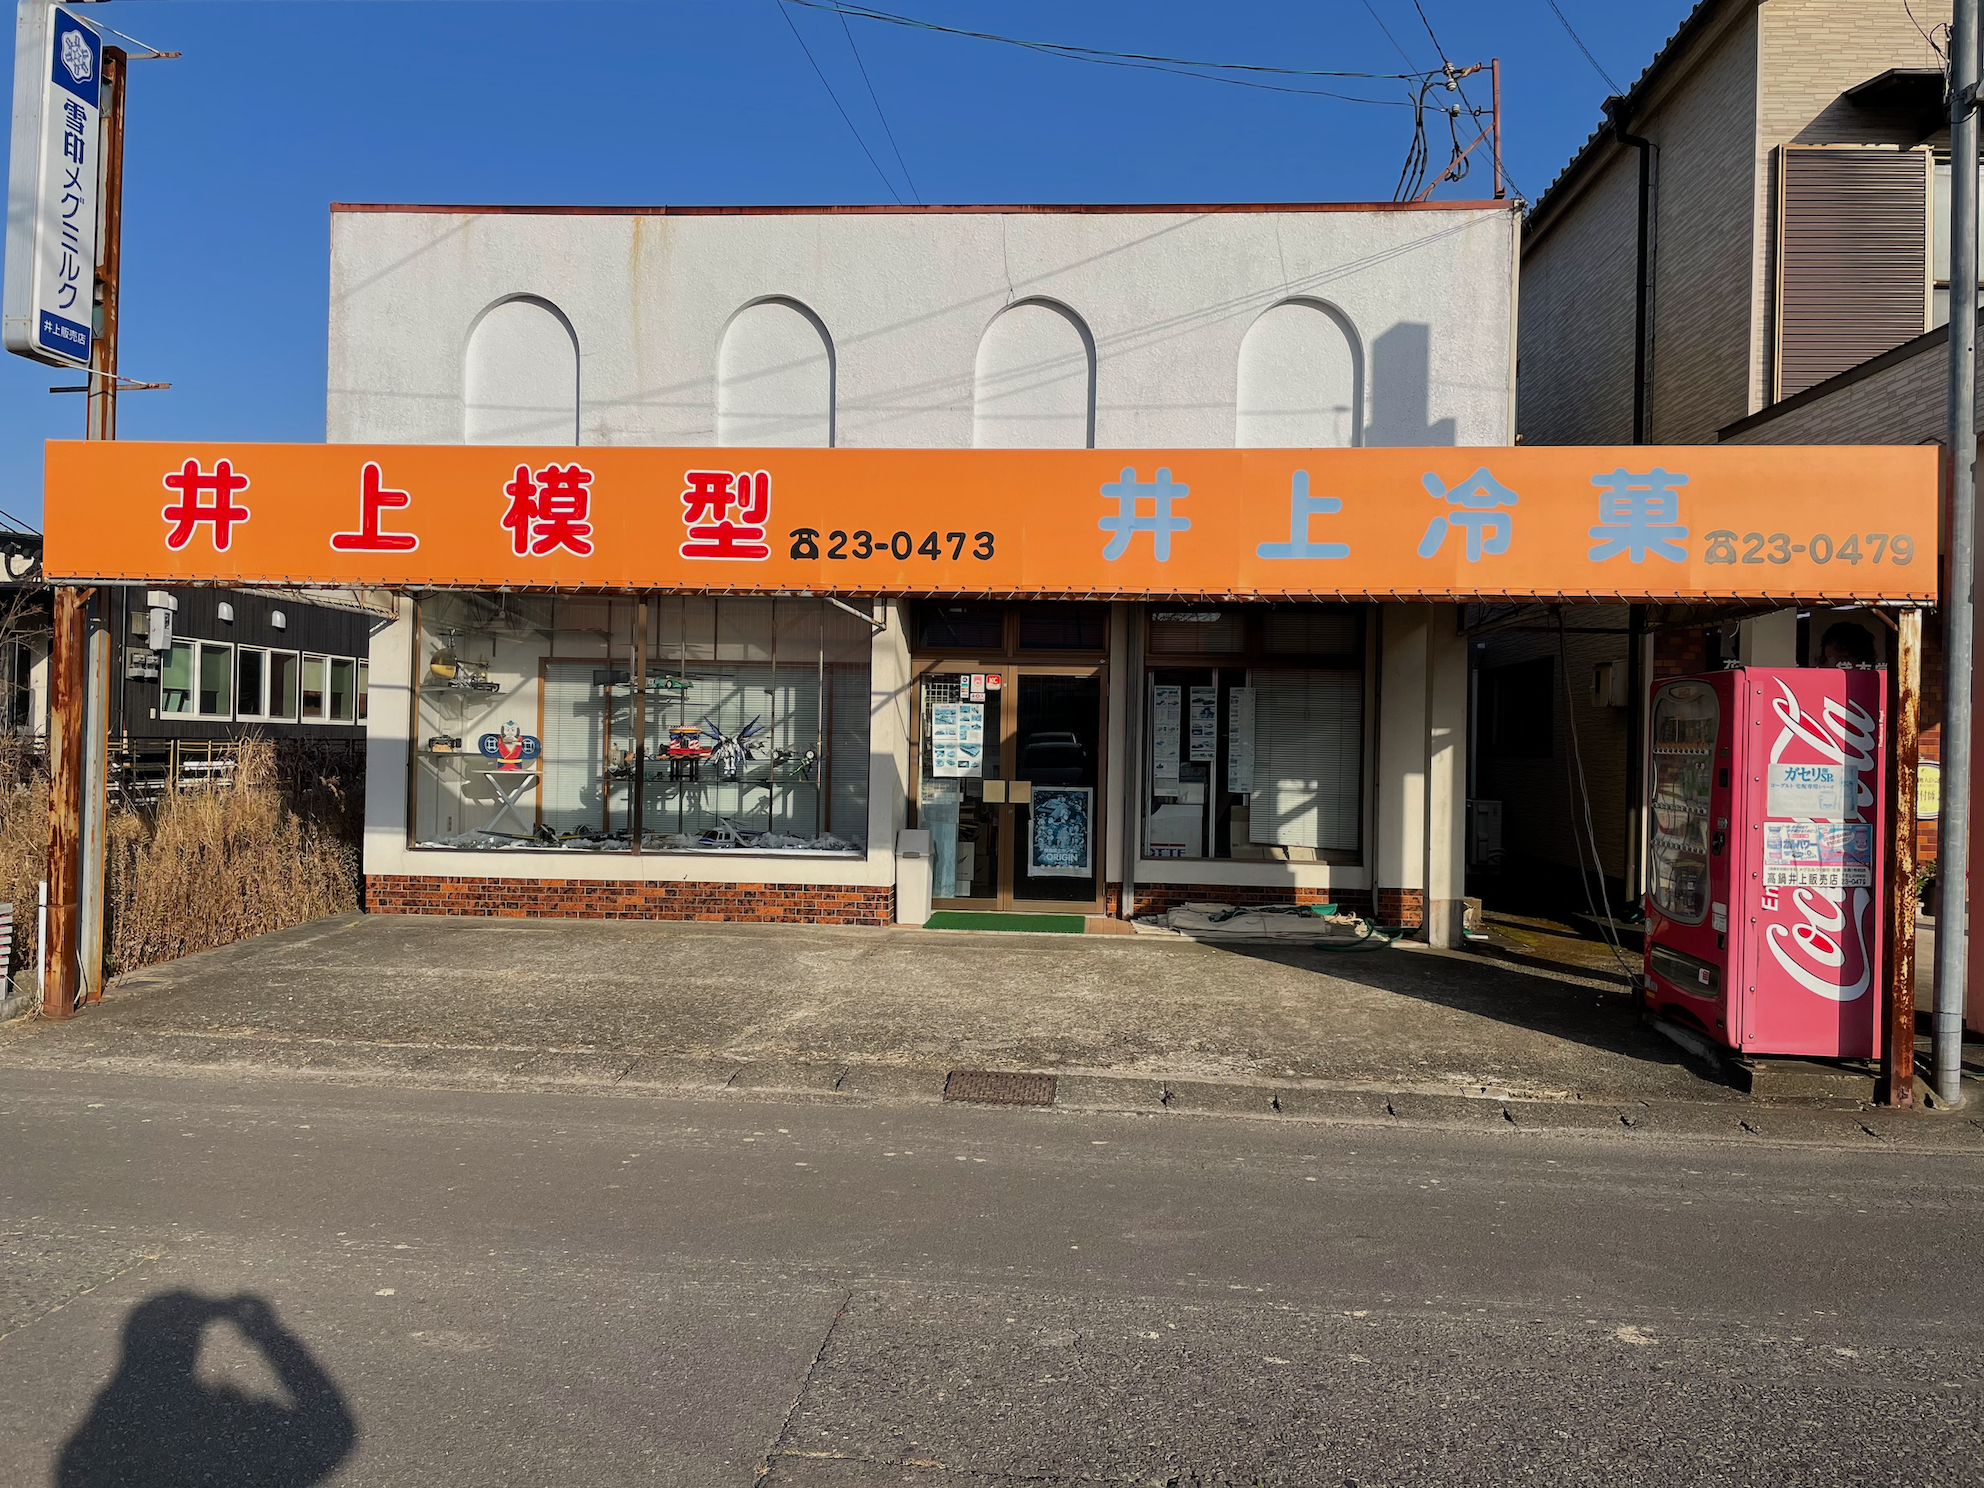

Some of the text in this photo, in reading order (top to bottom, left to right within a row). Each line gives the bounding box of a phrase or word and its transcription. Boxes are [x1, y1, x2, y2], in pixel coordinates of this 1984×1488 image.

[58, 98, 87, 310] 雪印メグミルク
[43, 320, 87, 346] 井上販売店
[161, 457, 772, 561] 井上模型
[1098, 466, 1690, 564] 井上冷菓
[827, 530, 995, 561] 23-0473
[1741, 532, 1915, 566] 23-0479
[1046, 853, 1078, 861] ORIGIN
[1767, 872, 1838, 885] 高鍋井上販売店
